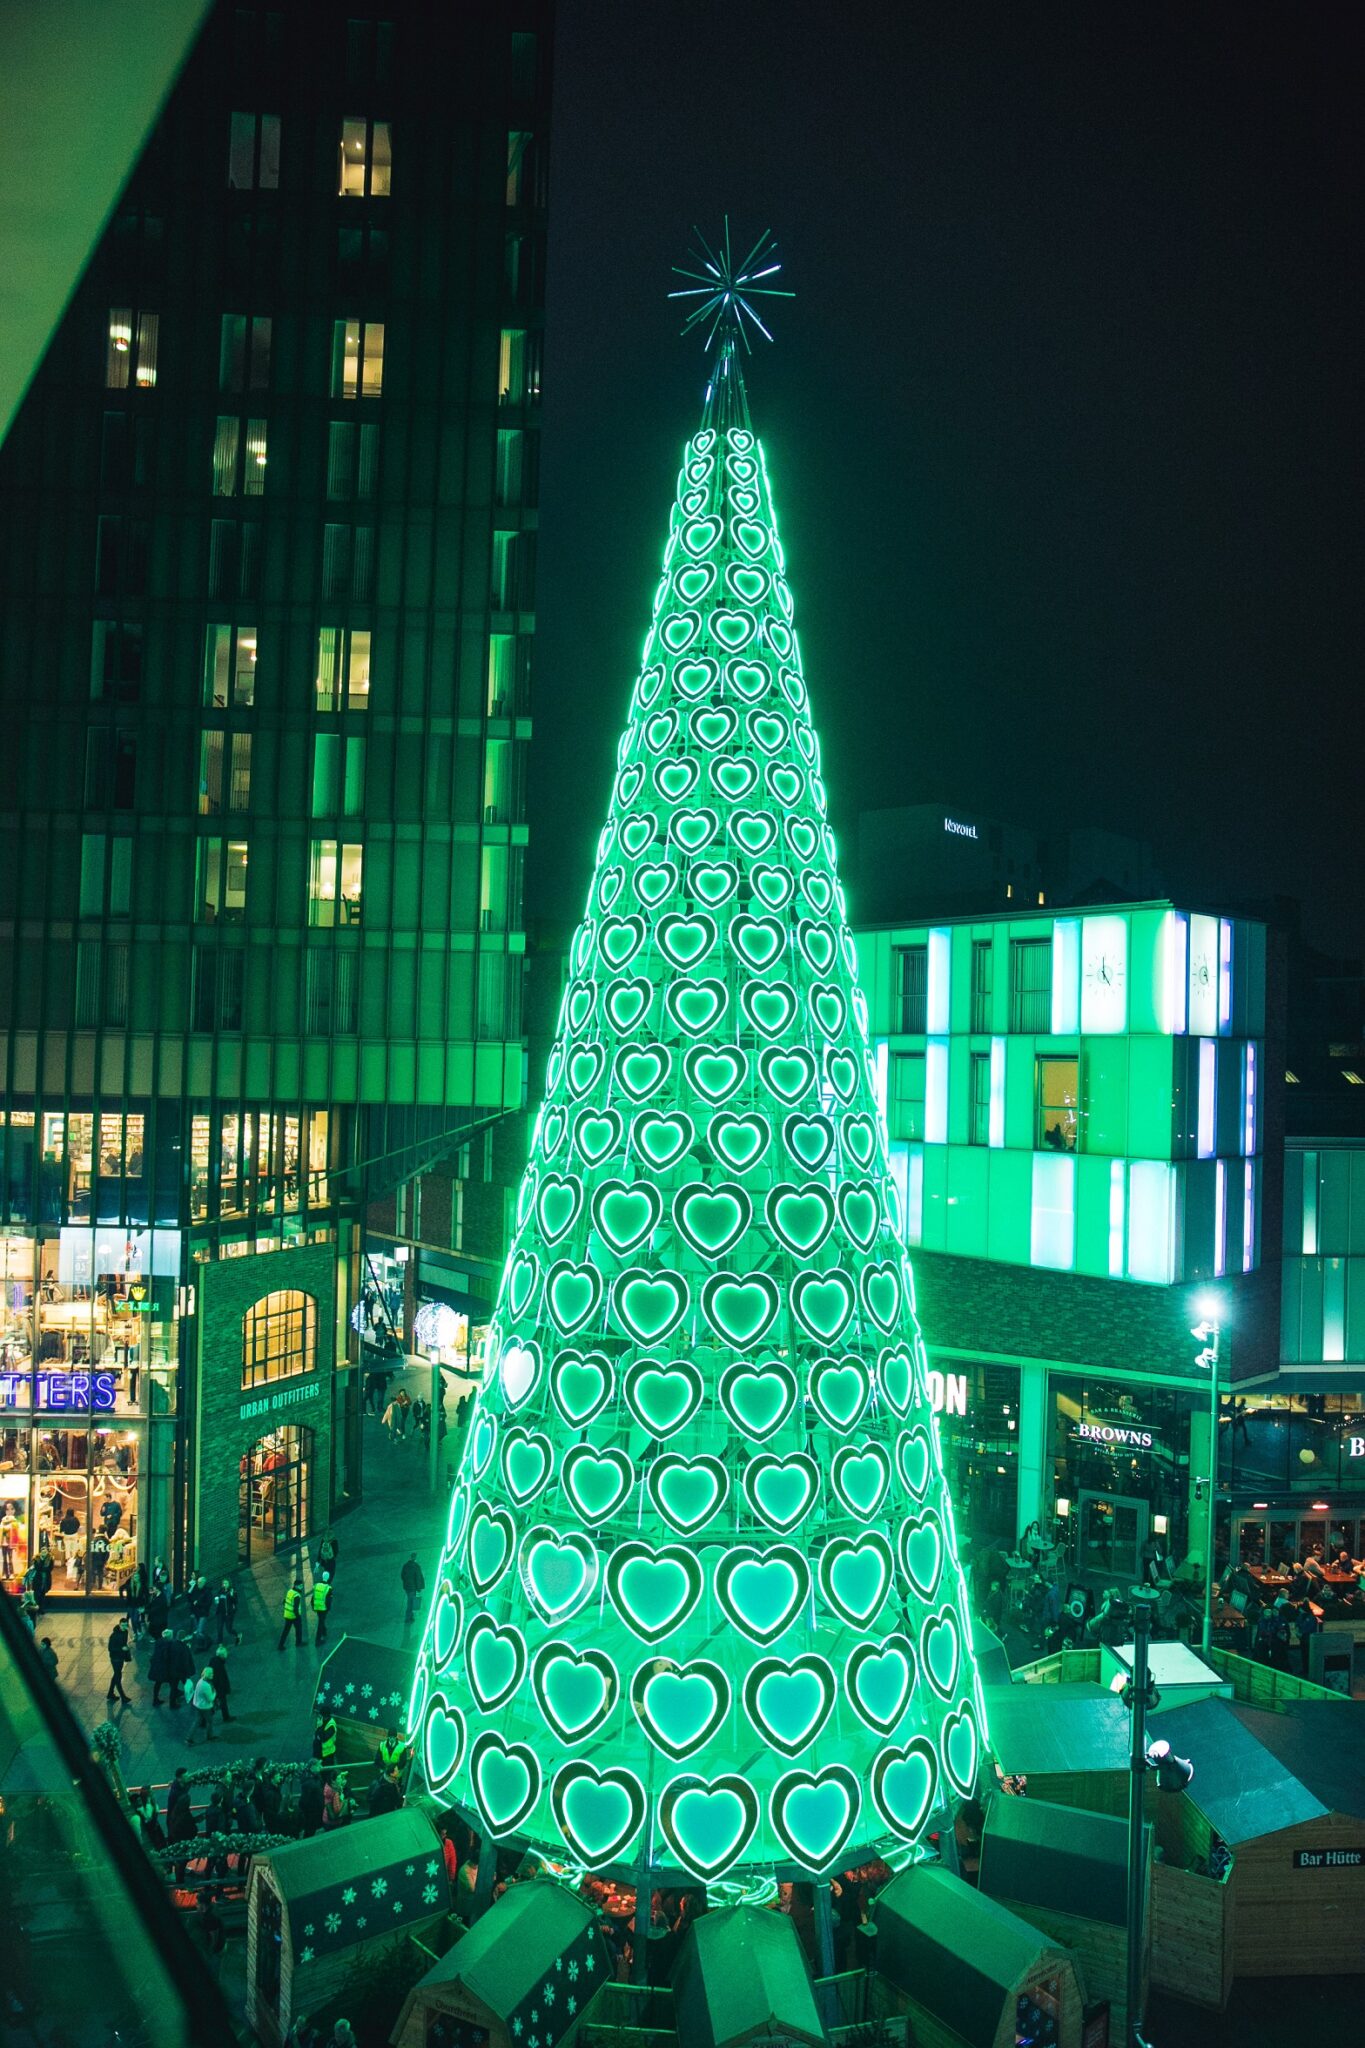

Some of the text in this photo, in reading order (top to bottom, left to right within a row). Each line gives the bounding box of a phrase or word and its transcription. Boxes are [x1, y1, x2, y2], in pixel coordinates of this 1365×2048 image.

[240, 1383, 320, 1420] URBAN OUTFITTERS
[1079, 1423, 1152, 1447] BROWNS
[1300, 1851, 1362, 1866] Bar Hütte
